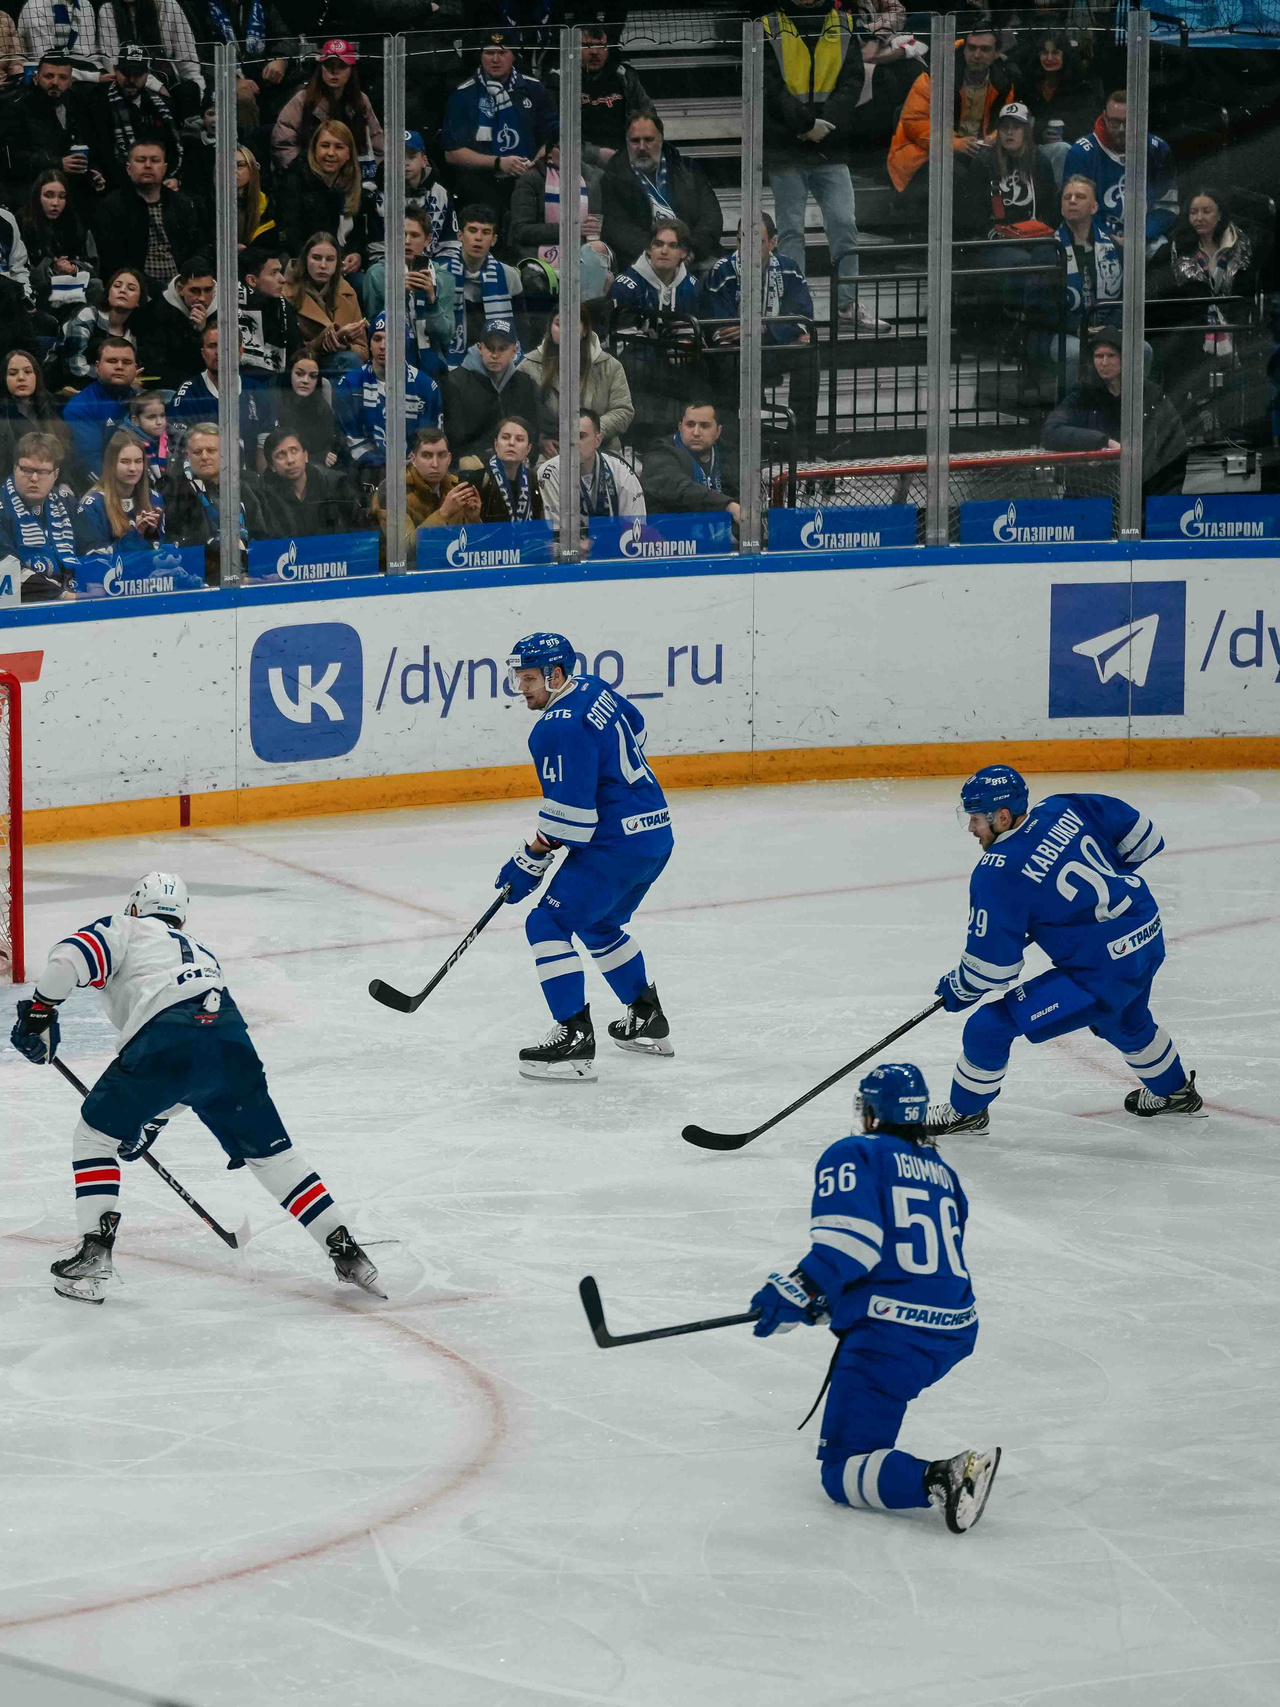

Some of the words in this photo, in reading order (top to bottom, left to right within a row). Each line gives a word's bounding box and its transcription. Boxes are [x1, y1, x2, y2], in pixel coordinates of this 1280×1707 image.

[1018, 526, 1075, 542] ГАЗПРОМ
[1205, 522, 1264, 537] ГАЗПРОМ
[643, 540, 697, 557] ГАЗПРОМ
[825, 532, 881, 549] ГАЗПРОМ
[469, 549, 521, 566] ГАЗПРОМ
[298, 562, 348, 580] ГАЗПРОМ
[125, 577, 174, 595] ГАЗПРОМ
[375, 643, 723, 718] /dyno_ru
[545, 709, 572, 721] ВТБ
[542, 754, 563, 783] 41
[1021, 808, 1084, 884] KABLUKOV
[980, 853, 1007, 868] ВТБ
[164, 884, 174, 895] 17
[1031, 1002, 1059, 1021] BAUER
[904, 1106, 919, 1121] 56
[818, 1162, 857, 1198] 56
